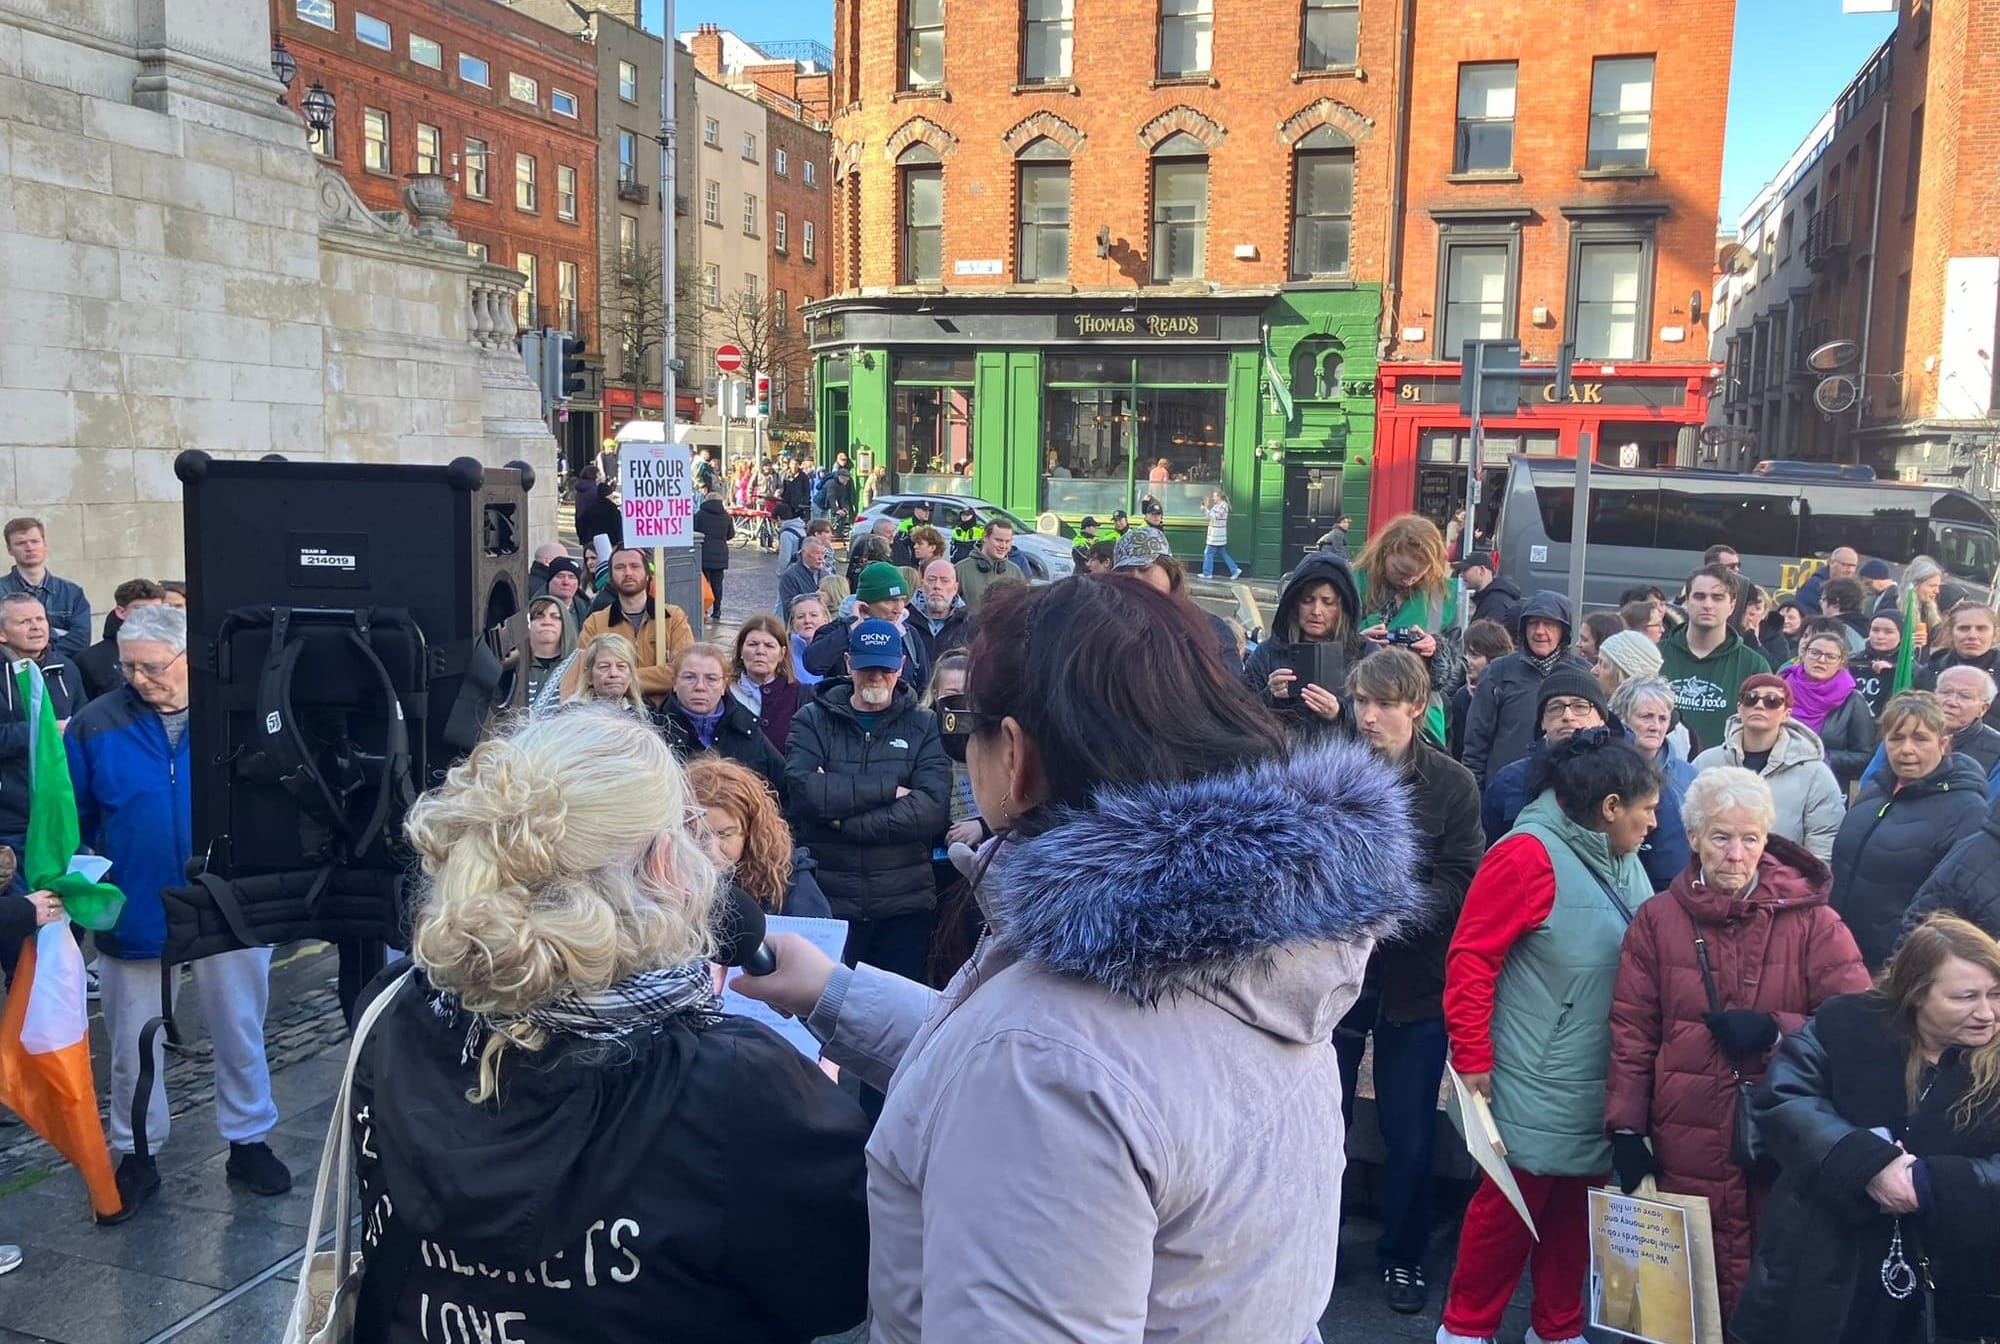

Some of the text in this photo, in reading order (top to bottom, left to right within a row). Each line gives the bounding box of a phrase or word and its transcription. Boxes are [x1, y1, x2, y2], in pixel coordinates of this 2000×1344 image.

[1074, 313, 1199, 337] THOMAS READ'S
[1401, 384, 1421, 402] 81
[629, 460, 684, 478] FIX OUR
[634, 479, 682, 497] HOMES
[625, 498, 691, 517] DROP THE
[636, 517, 682, 536] RENTS!
[307, 556, 349, 565] 214019
[860, 633, 891, 642] DKNY
[1608, 1202, 1623, 1213] filth
[1633, 1204, 1642, 1213] us
[1643, 1208, 1664, 1221] leave
[1604, 1214, 1670, 1237] of our money and
[1607, 1229, 1620, 1238] rob
[1622, 1232, 1658, 1248] landlords
[1659, 1241, 1680, 1252] while
[1610, 1243, 1669, 1265] We live like this
